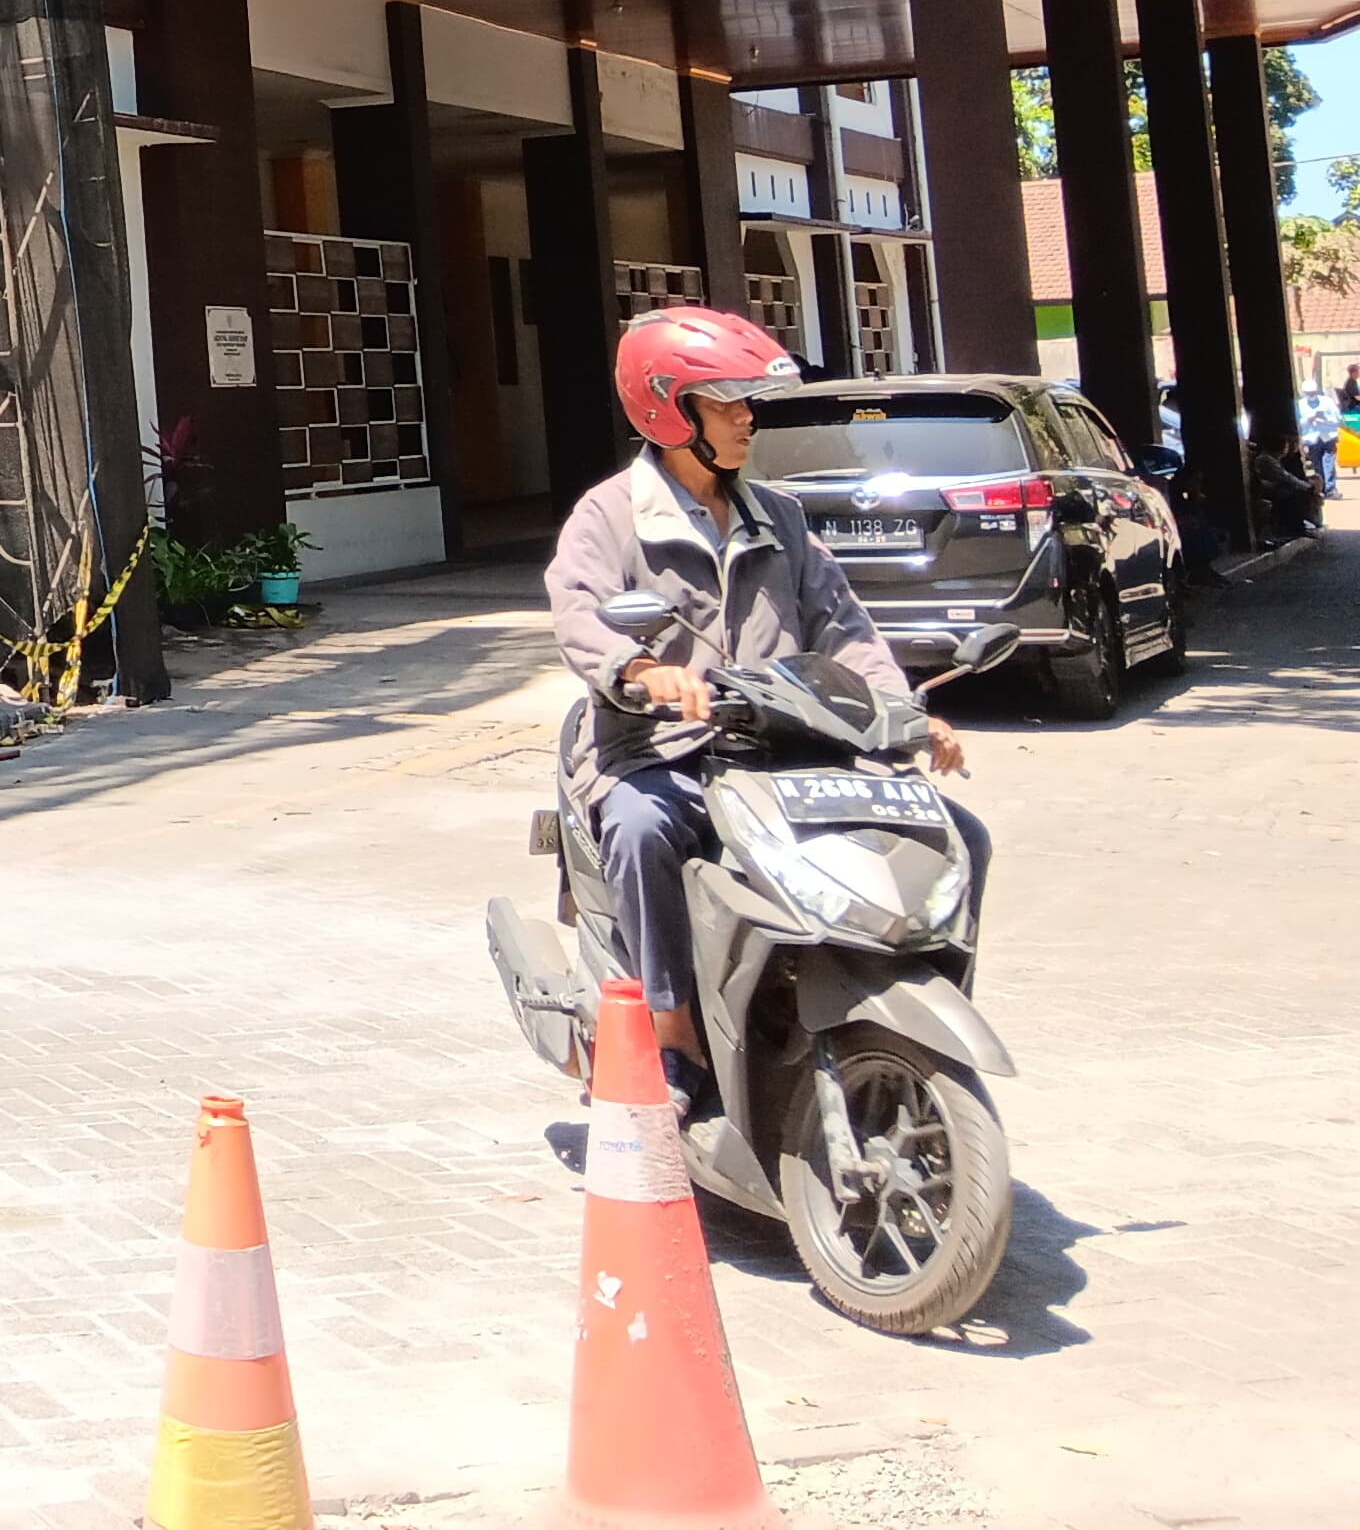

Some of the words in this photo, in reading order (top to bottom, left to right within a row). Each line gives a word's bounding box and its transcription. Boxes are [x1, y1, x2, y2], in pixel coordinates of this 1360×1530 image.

[825, 520, 837, 536] N
[850, 519, 882, 536] 1138
[893, 518, 917, 536] ZG
[882, 781, 931, 803] AAV
